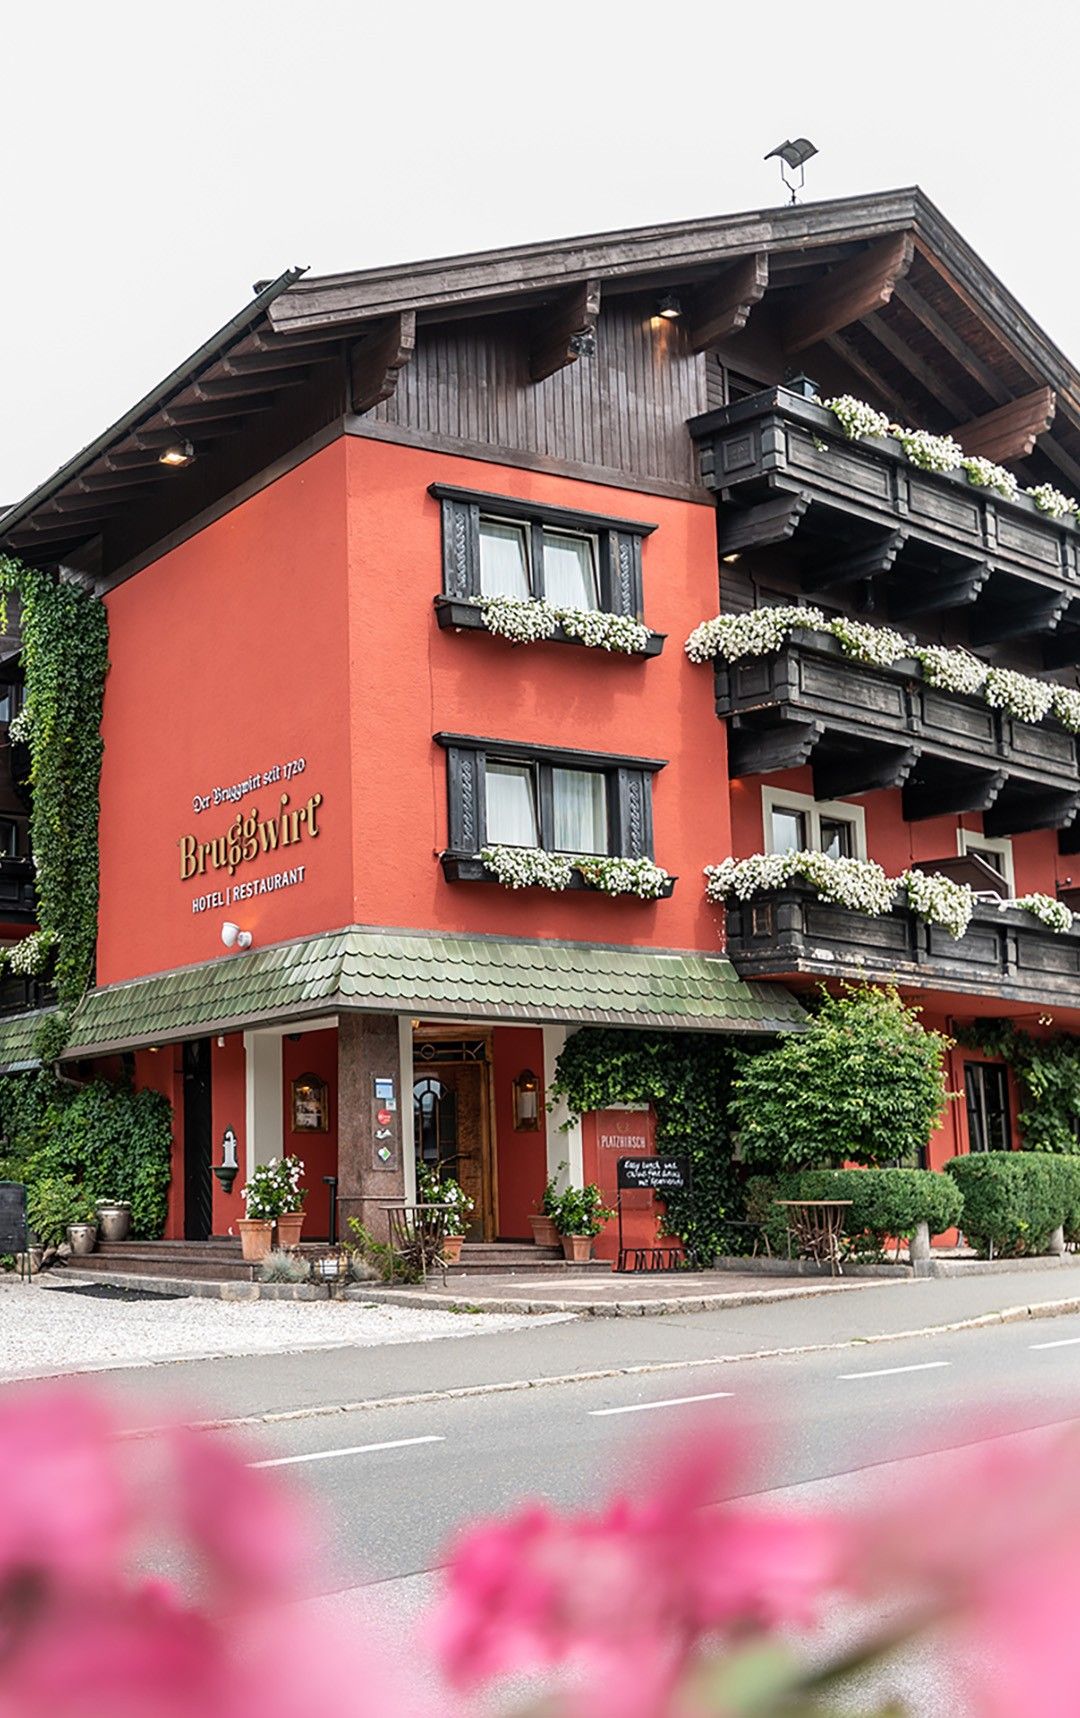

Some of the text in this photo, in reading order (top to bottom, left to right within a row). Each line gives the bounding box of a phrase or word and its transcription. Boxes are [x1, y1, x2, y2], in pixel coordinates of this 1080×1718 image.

[193, 758, 305, 813] Der Bruggwirt seit 1720
[178, 793, 323, 880] Bruggwirt
[192, 891, 225, 914] HOTEL
[233, 866, 305, 902] RESTAURANT
[601, 1135, 646, 1148] PLATZHIRSCH
